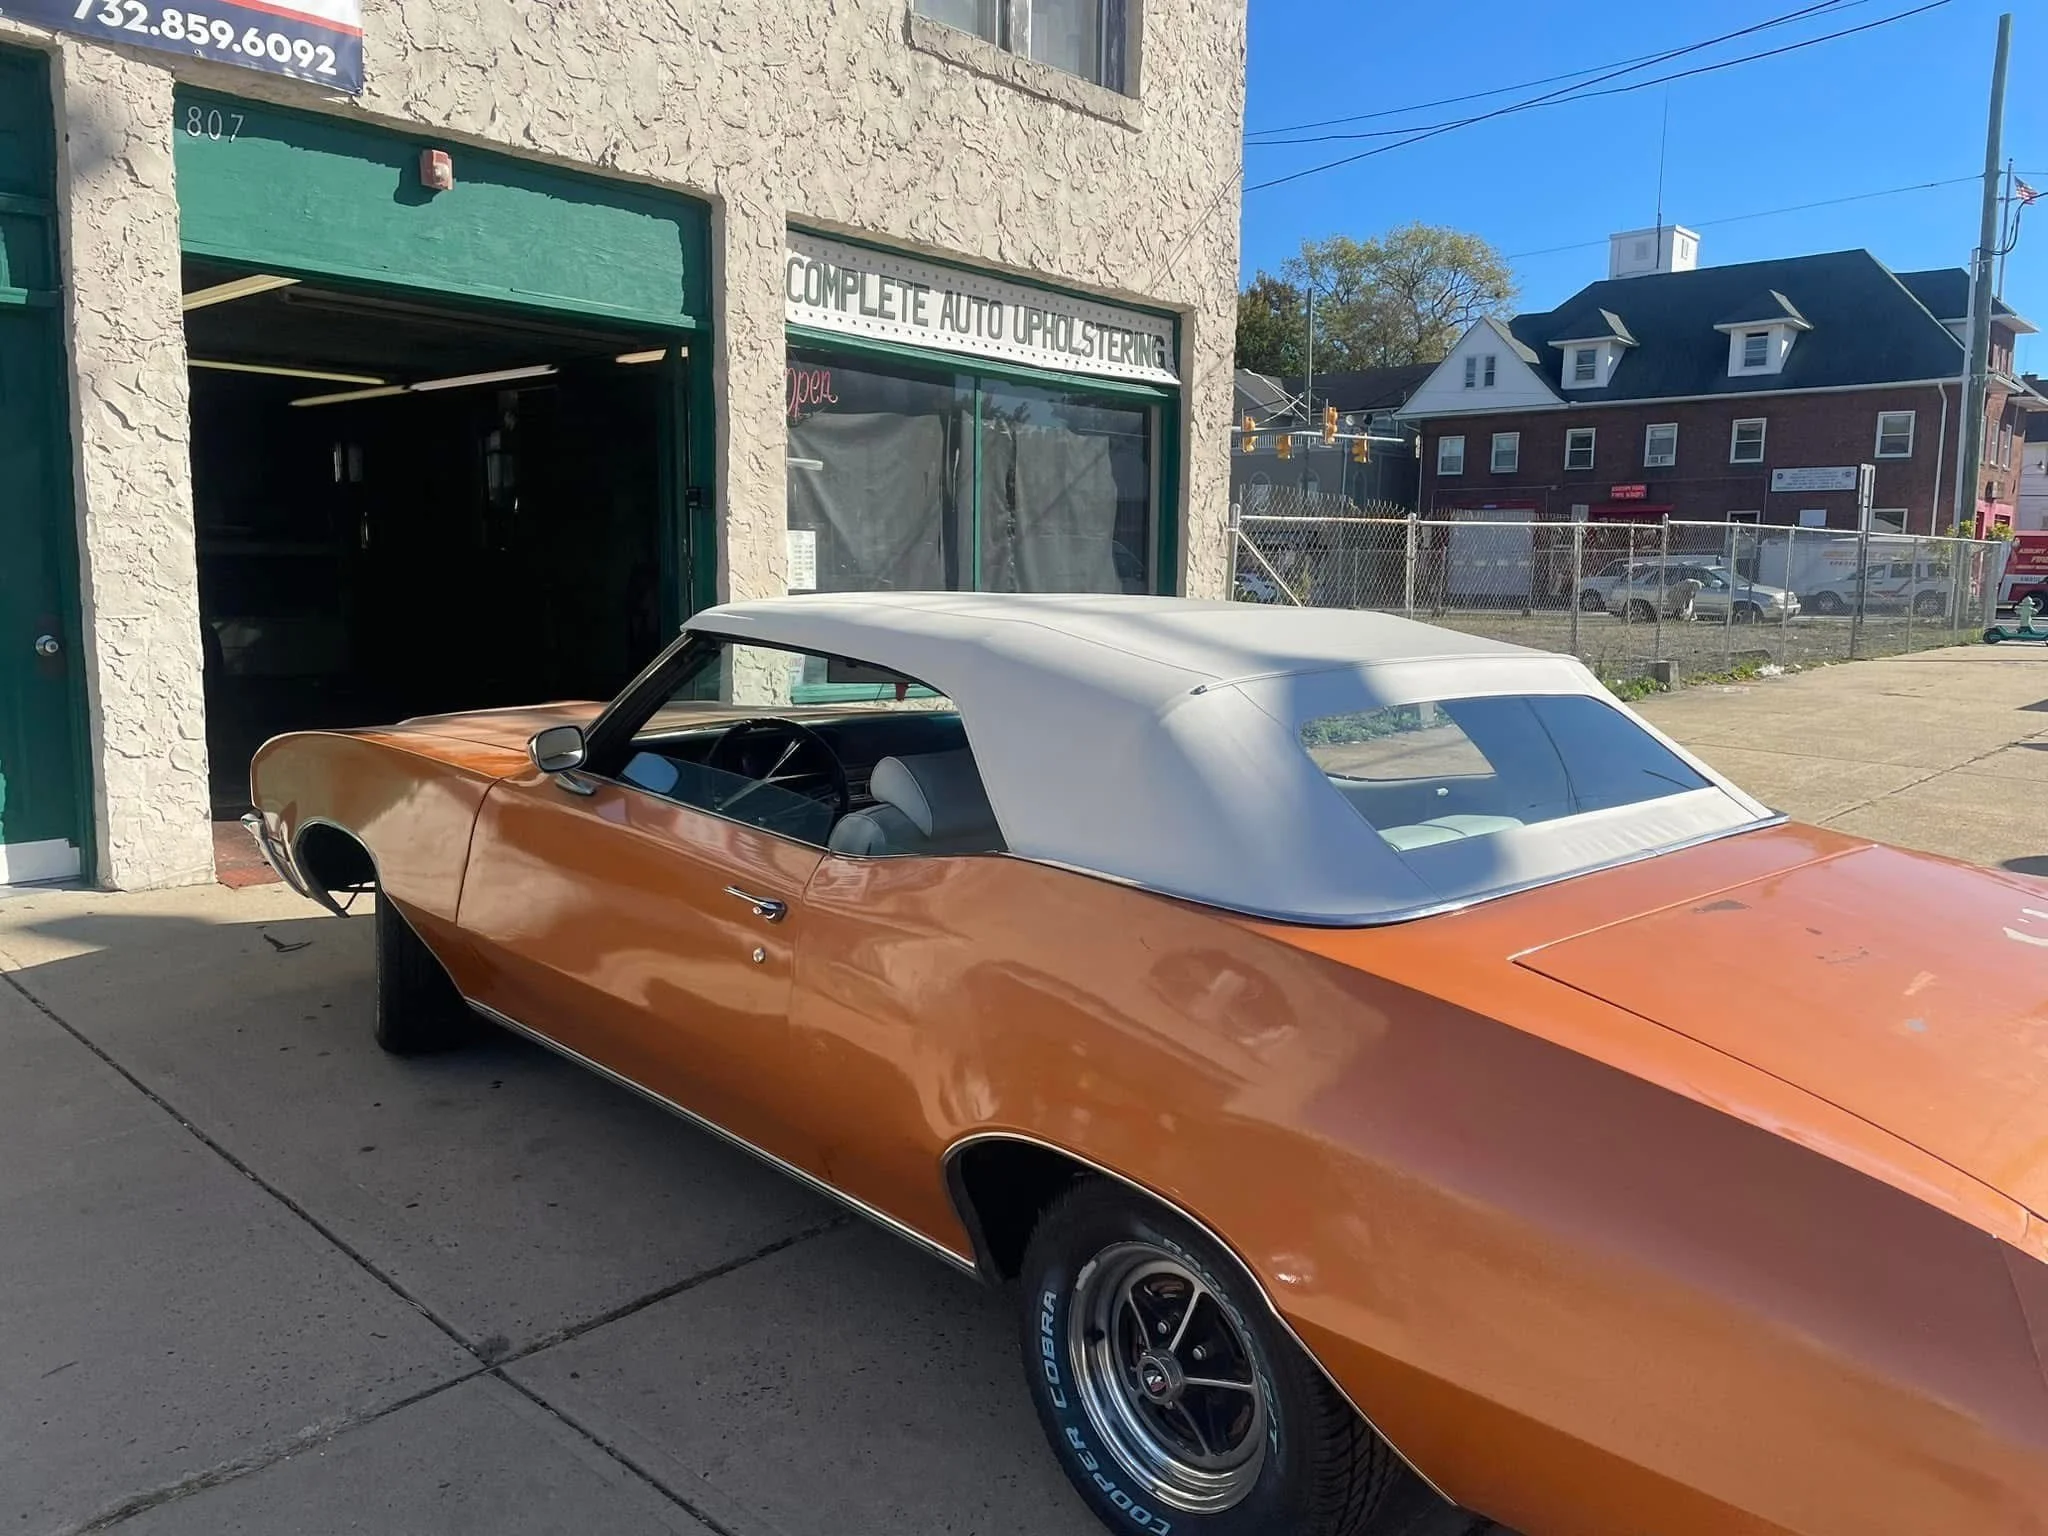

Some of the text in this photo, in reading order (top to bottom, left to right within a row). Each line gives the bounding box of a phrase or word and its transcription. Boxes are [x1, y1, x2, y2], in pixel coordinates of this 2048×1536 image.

[186, 105, 244, 143] 807
[786, 256, 1166, 368] COMPLETE AUTO UPHOLSTERING
[1040, 1290, 1172, 1536] COOPER COBRA
